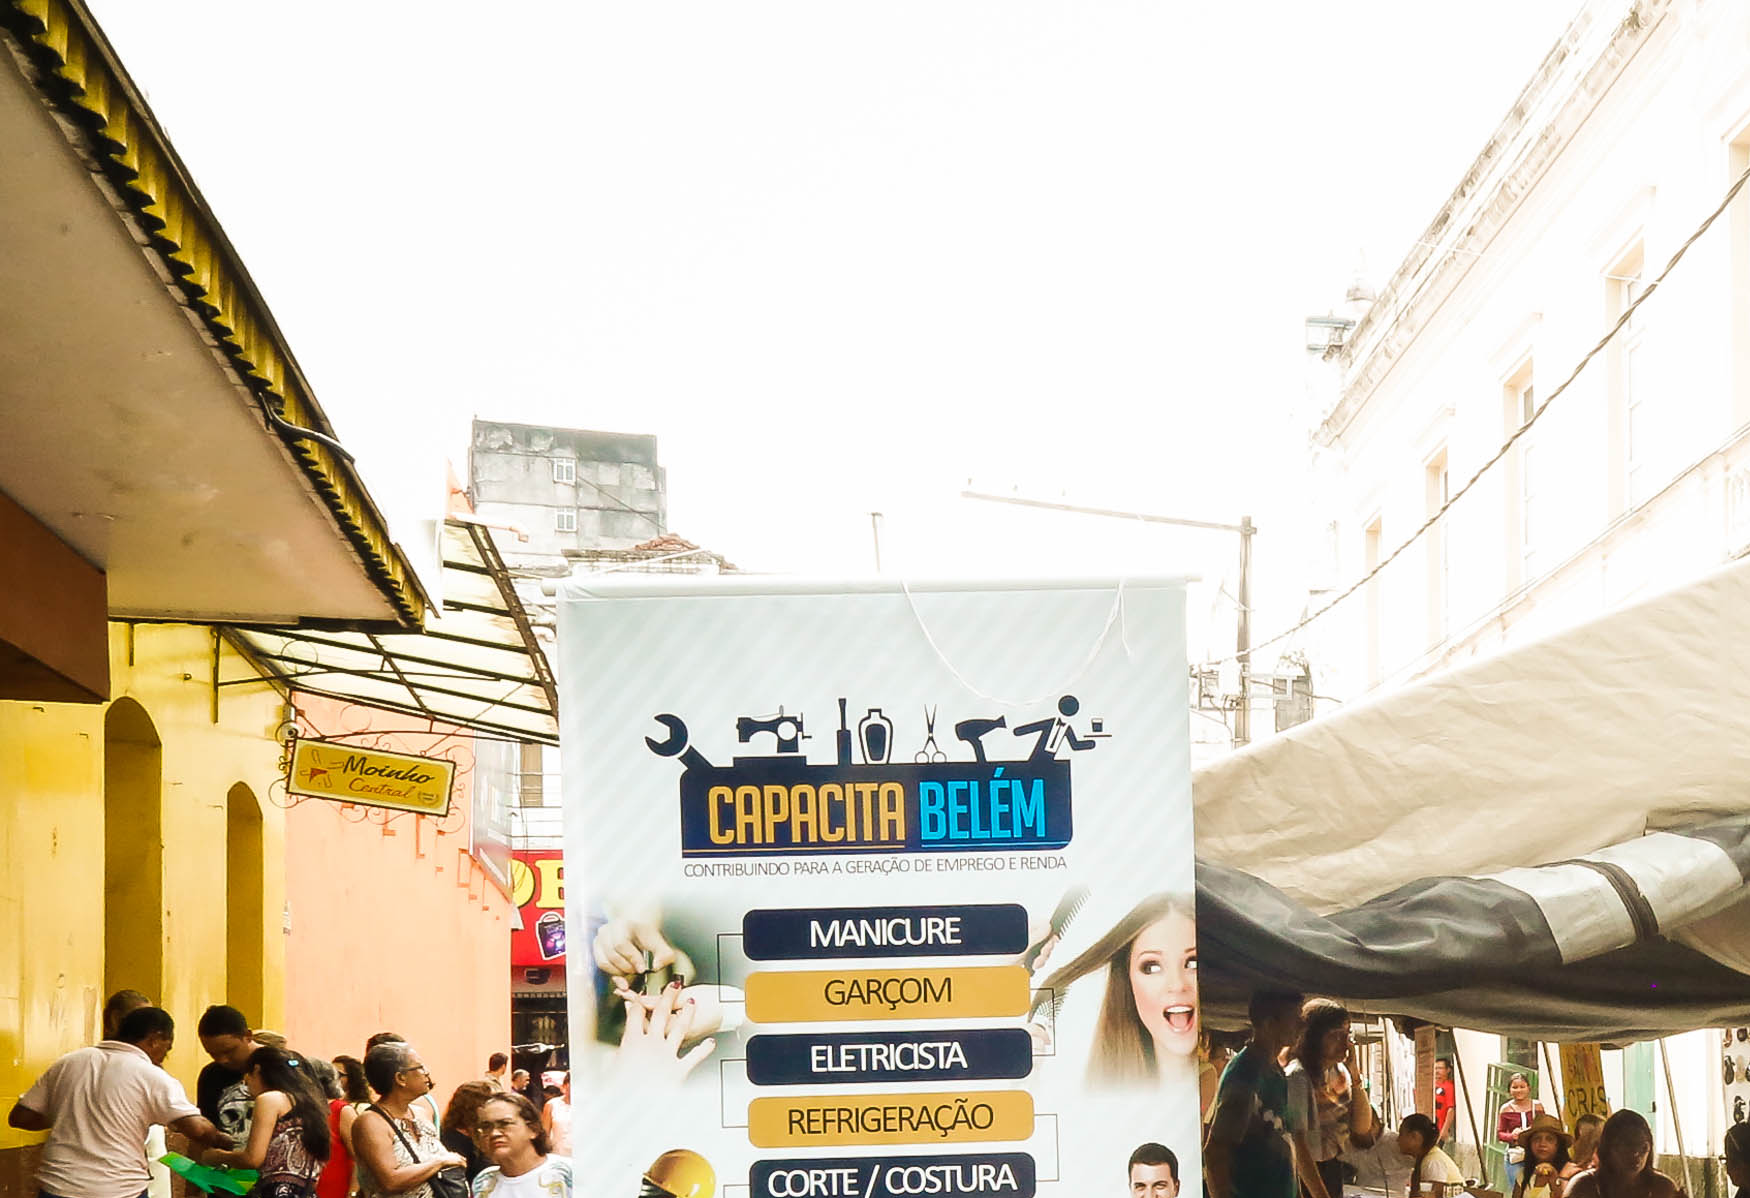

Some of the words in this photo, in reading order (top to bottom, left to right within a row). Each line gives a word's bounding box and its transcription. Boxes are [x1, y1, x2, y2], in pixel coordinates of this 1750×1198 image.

[343, 755, 435, 784] Moinho
[349, 777, 416, 799] Central
[706, 781, 905, 844] CAPACITA
[919, 768, 1046, 840] BELÉM
[684, 862, 789, 877] CONTRIBUINDO
[793, 861, 828, 875] PARA
[832, 861, 842, 873] A
[845, 857, 910, 876] GERAÇÃO
[914, 858, 932, 873] DE
[936, 857, 1005, 872] EMPREGO
[1009, 857, 1017, 870] E
[1020, 856, 1067, 870] RENDA
[809, 917, 962, 947] MANICURE
[824, 976, 953, 1009] GARÇOM
[811, 1040, 968, 1073] ELETRICISTA
[788, 1098, 994, 1139] REFRIGERAÇÃO
[767, 1168, 860, 1198] CORTE
[884, 1163, 1018, 1195] COSTURA
